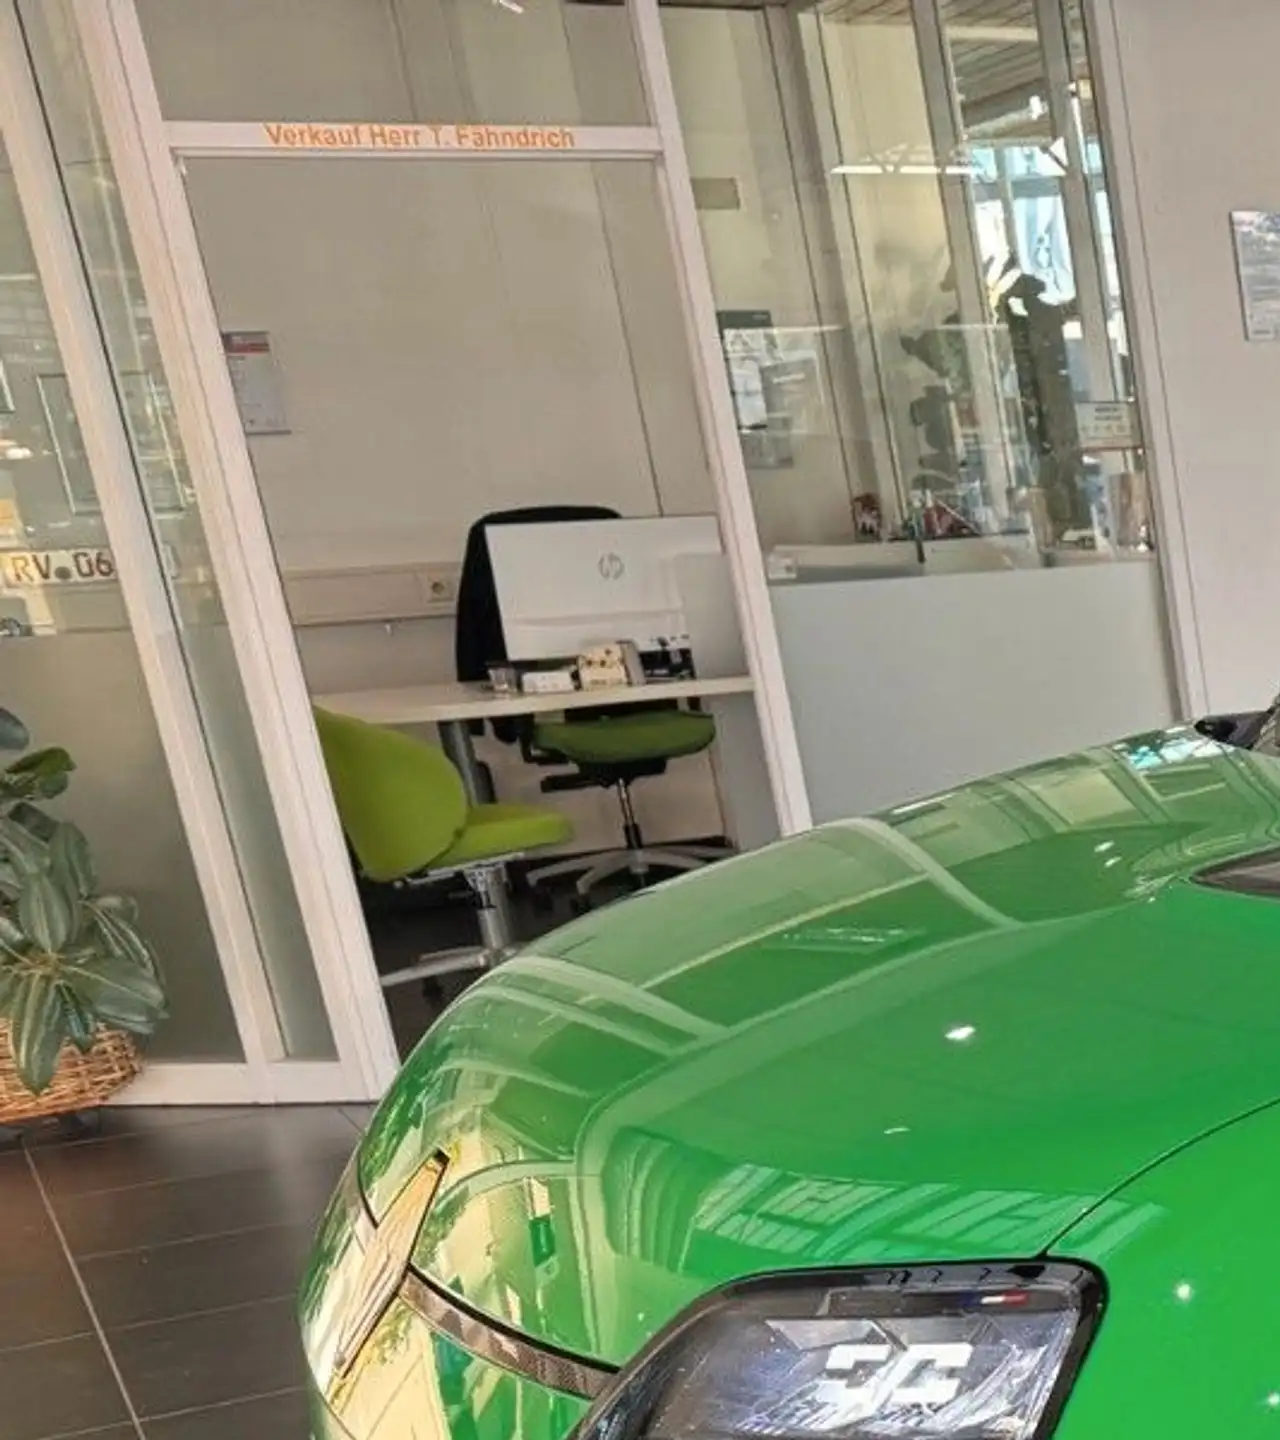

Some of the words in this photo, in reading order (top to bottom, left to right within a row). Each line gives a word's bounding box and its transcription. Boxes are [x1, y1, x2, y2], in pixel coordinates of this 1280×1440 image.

[265, 123, 361, 146] Verkauf
[369, 124, 420, 147] Herr
[11, 554, 50, 582] RV
